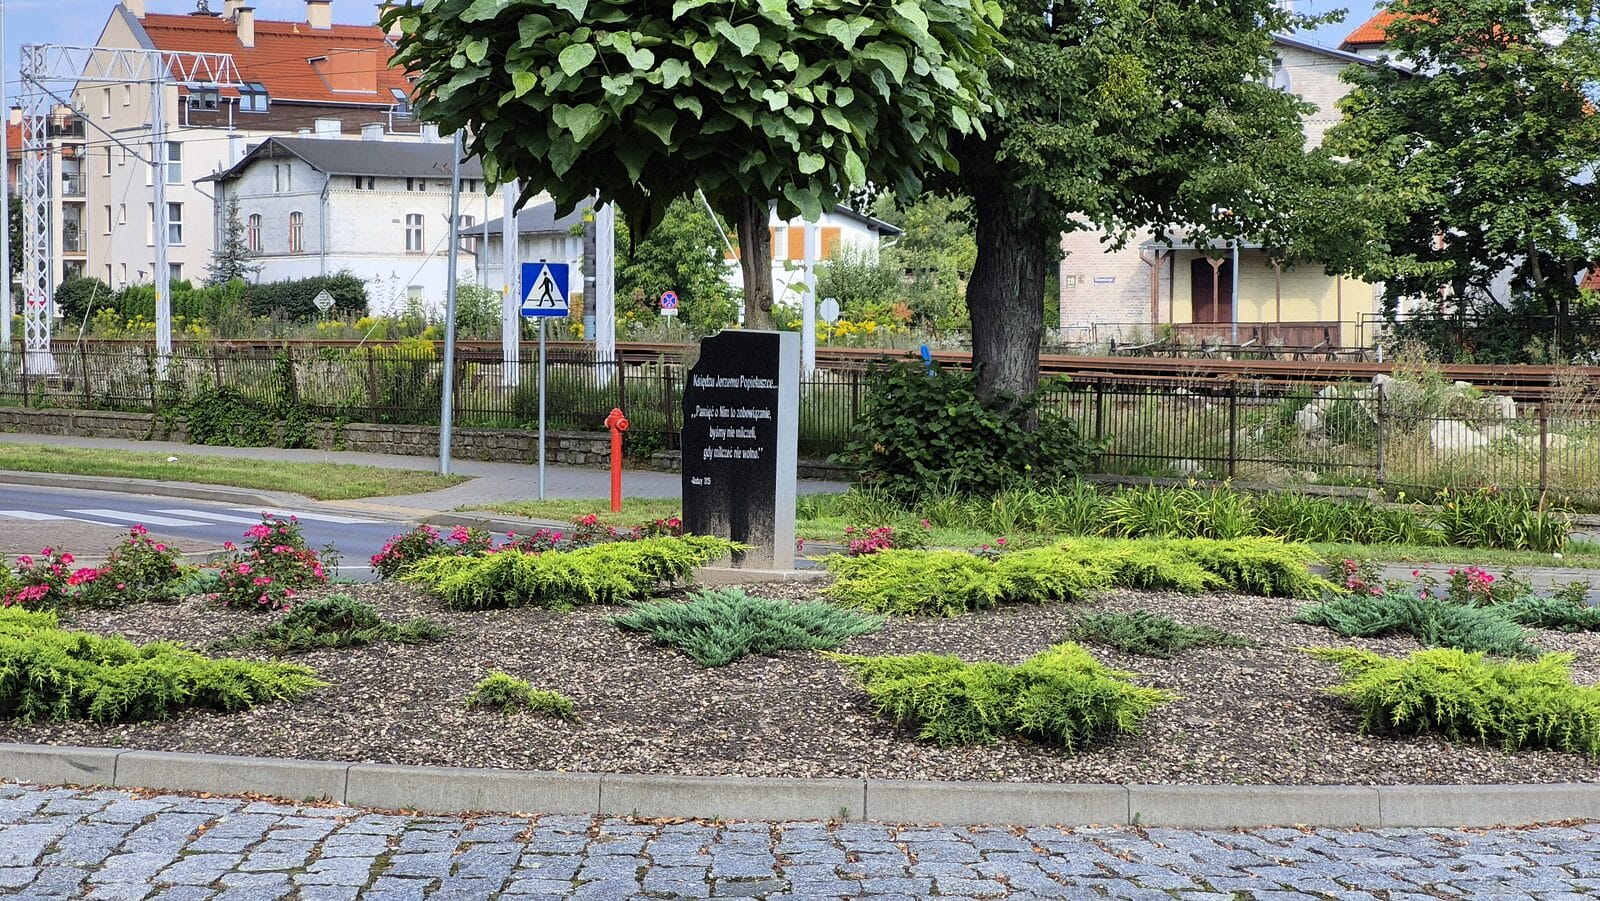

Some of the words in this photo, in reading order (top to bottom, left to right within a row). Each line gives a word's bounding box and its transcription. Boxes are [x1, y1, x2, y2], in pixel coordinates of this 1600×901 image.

[716, 374, 739, 388] Jerzemu
[715, 409, 719, 417] o
[719, 406, 730, 418] Nim
[730, 407, 736, 418] to
[709, 425, 726, 440] byśmy
[727, 426, 735, 438] nie
[703, 446, 713, 460] gdy
[714, 446, 733, 458] milczeć
[733, 447, 742, 459] nie
